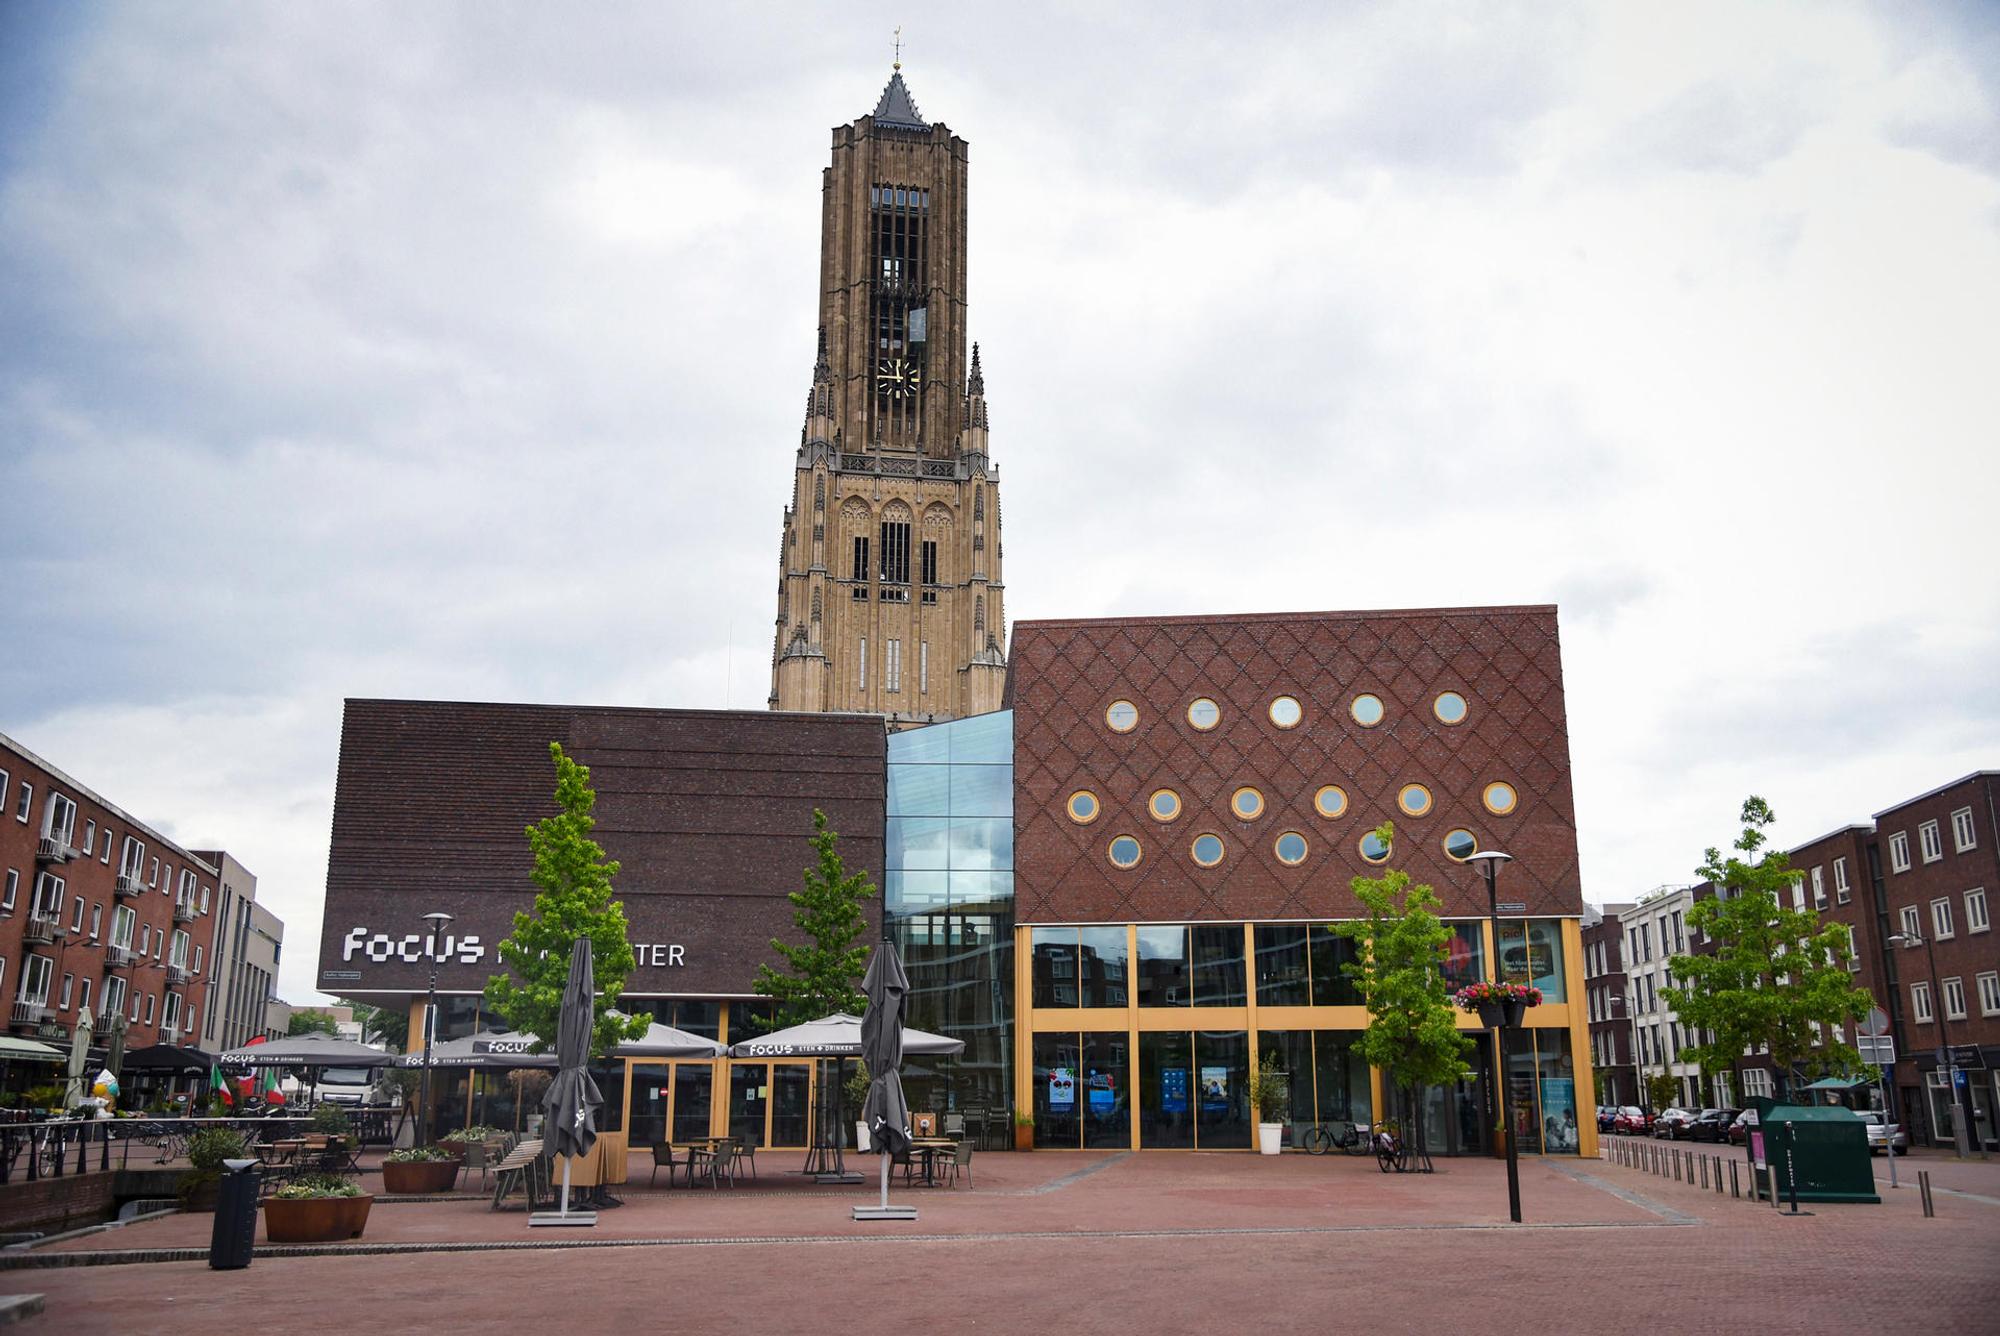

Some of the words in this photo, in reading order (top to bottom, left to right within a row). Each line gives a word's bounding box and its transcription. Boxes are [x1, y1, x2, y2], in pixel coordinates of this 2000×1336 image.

[343, 927, 485, 963] FOCUS
[750, 1044, 793, 1056] FOCUS
[221, 1054, 256, 1063] FOCUS
